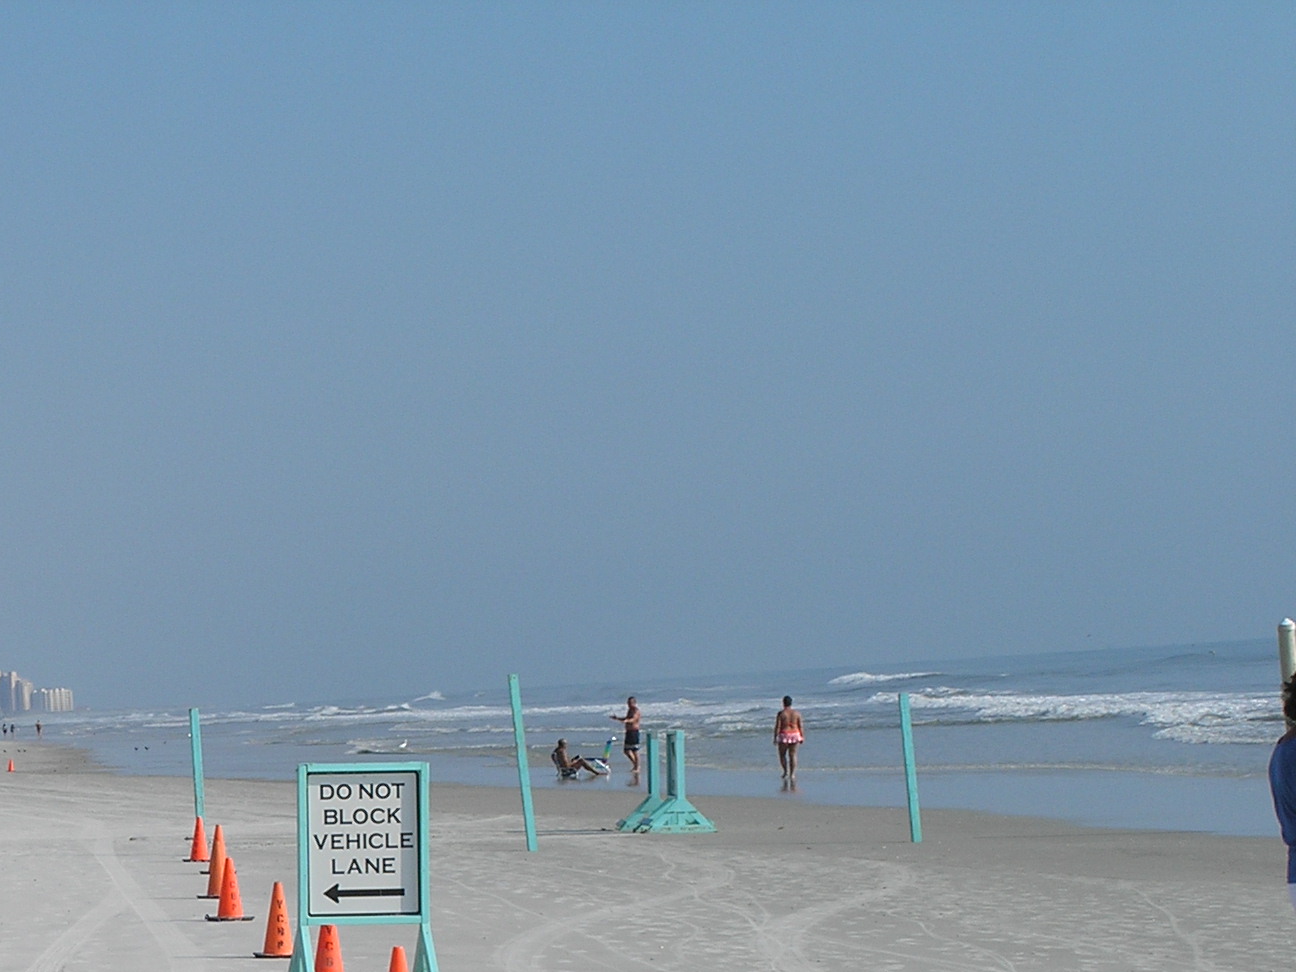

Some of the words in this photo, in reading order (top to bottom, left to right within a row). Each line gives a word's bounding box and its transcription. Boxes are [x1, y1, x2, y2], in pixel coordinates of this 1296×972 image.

[320, 784, 352, 800] DO
[359, 783, 405, 800] NOT
[324, 808, 401, 825] BLOCK
[314, 833, 414, 850] VEHICLE
[332, 858, 395, 875] LANE
